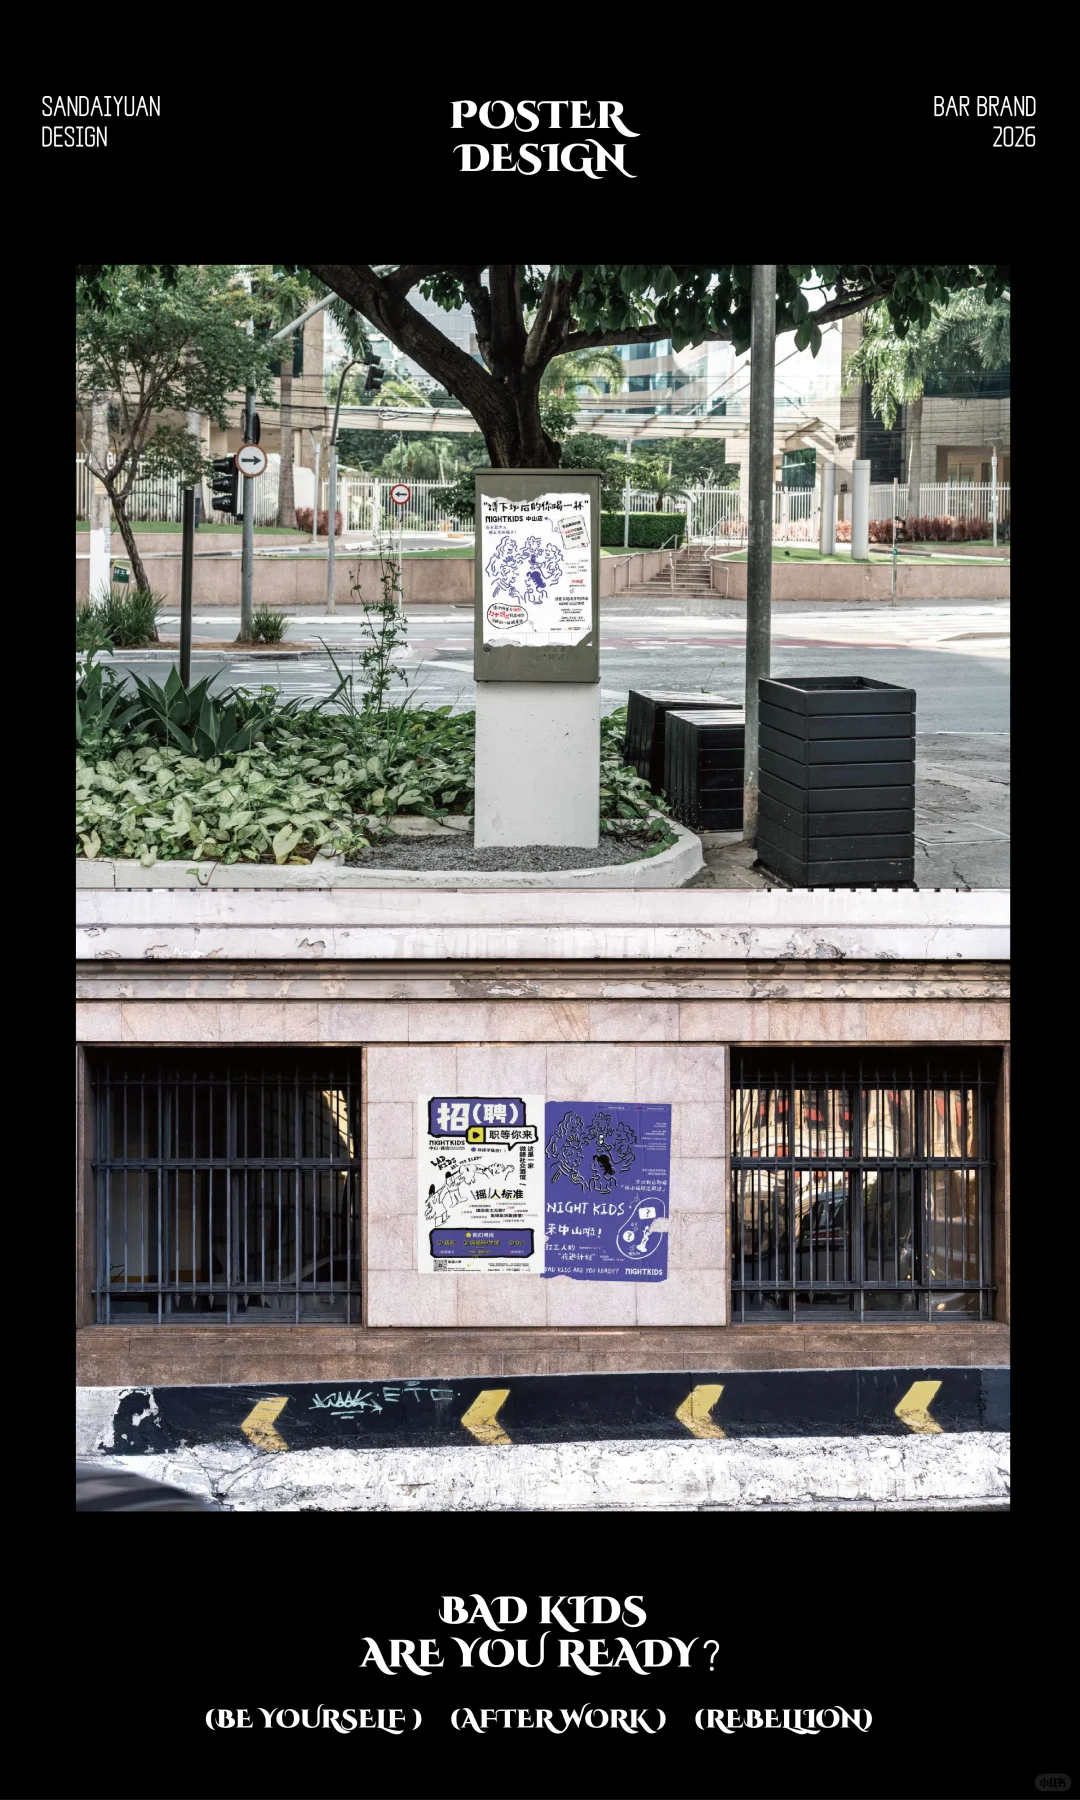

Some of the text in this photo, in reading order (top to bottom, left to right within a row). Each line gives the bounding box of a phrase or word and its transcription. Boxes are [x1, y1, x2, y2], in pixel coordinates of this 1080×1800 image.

[489, 1130, 533, 1140] 职等你来
[546, 1201, 625, 1216] NIGHT KIDS
[625, 1267, 663, 1276] NIGHTKIDS
